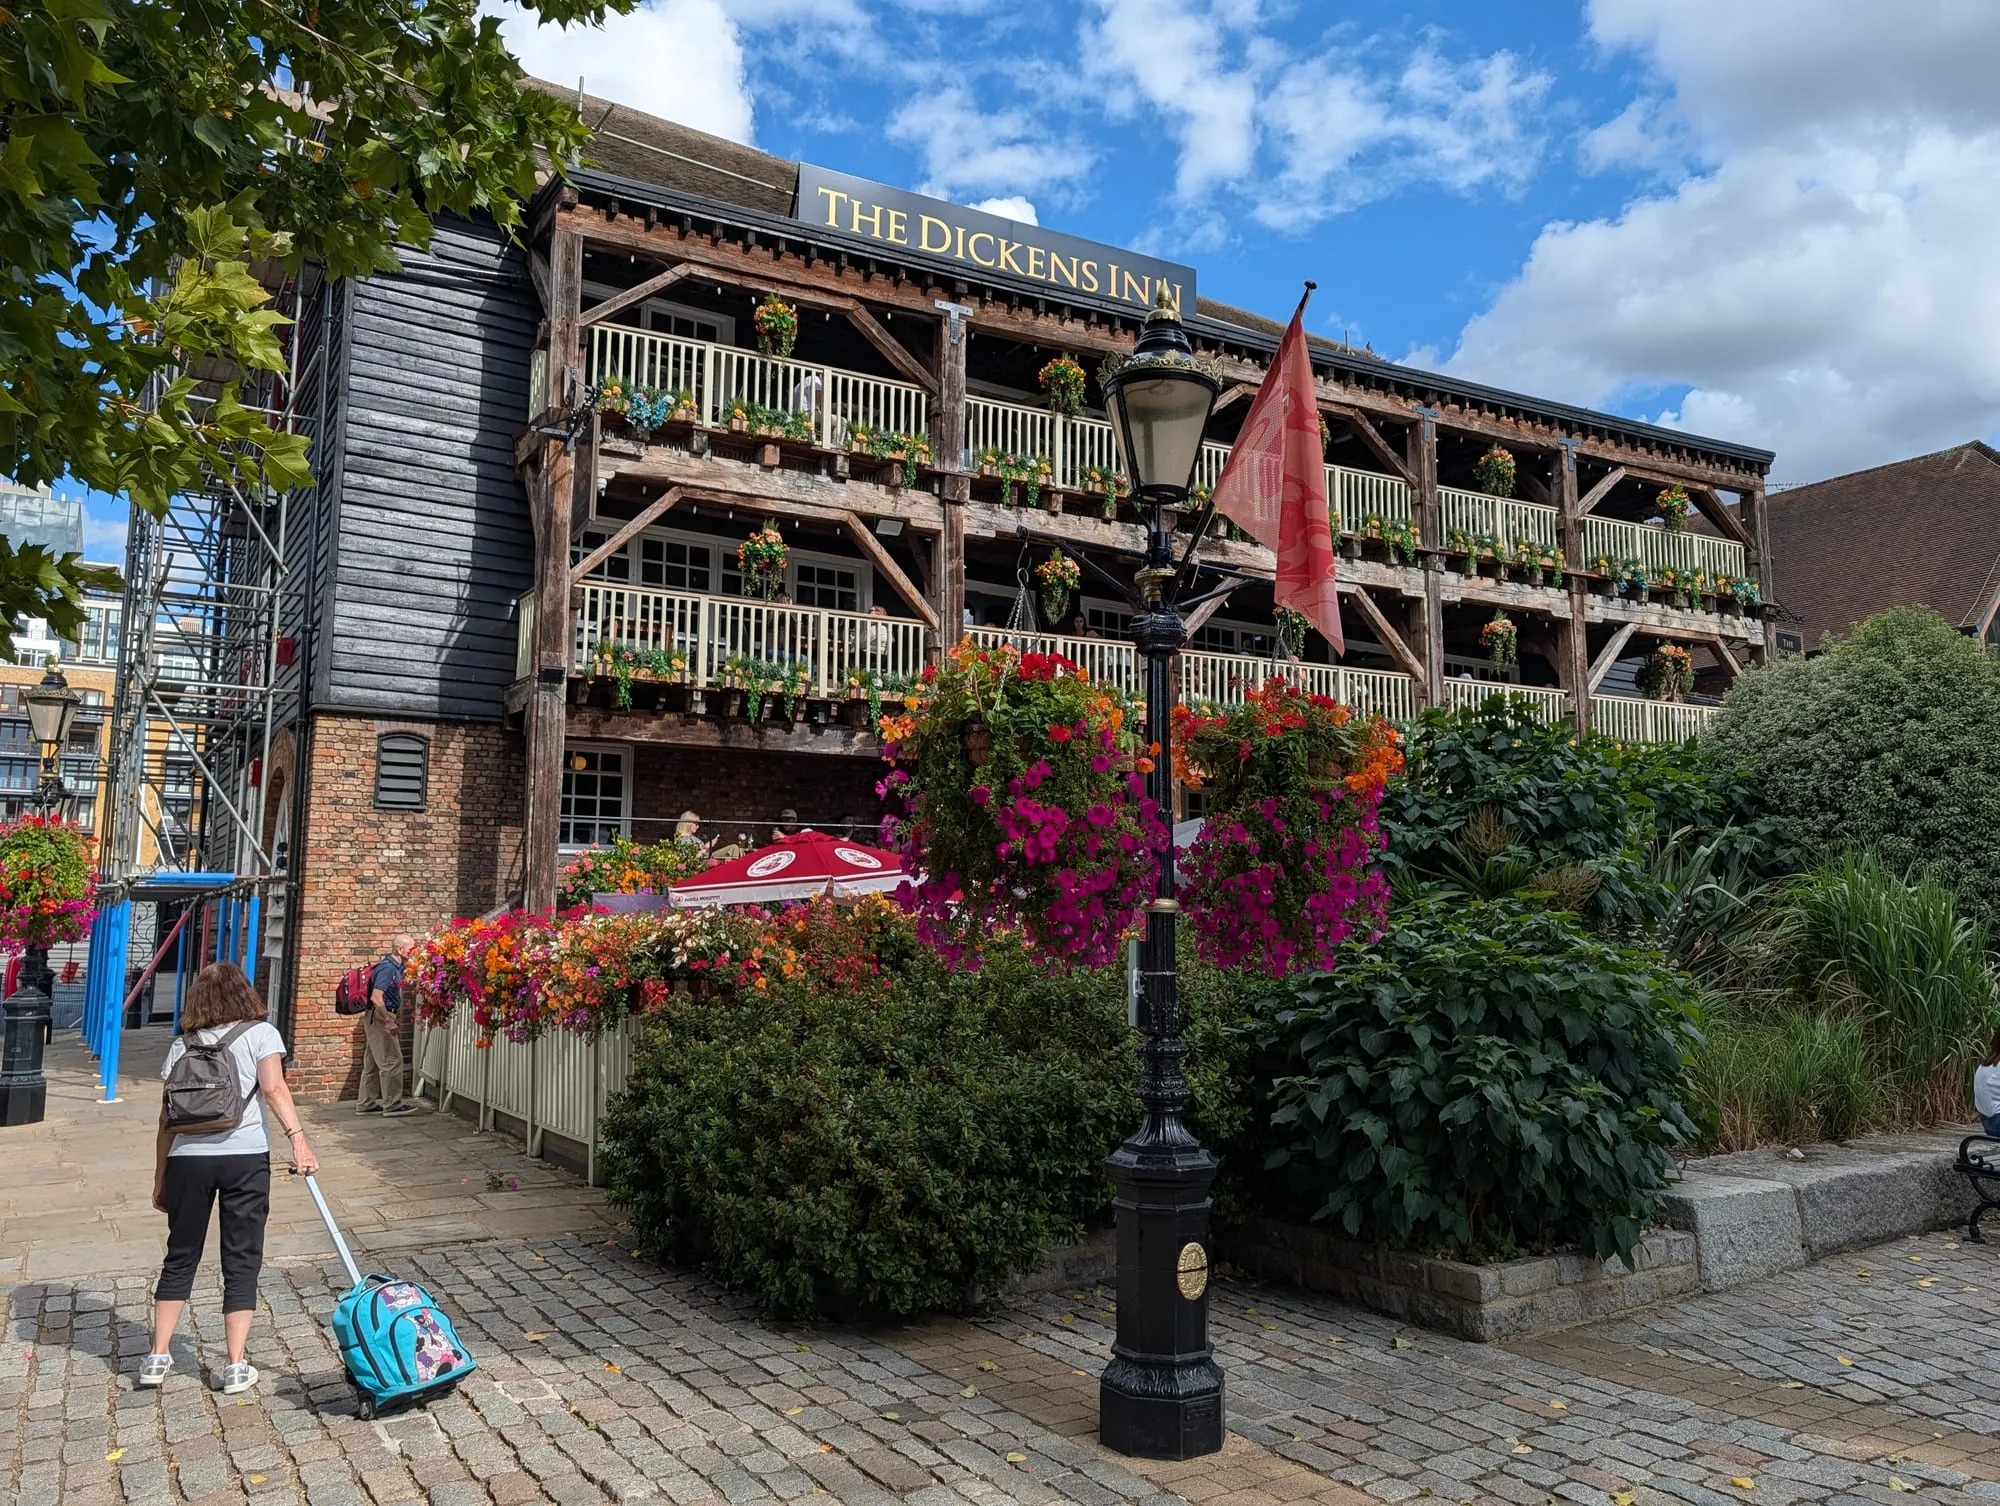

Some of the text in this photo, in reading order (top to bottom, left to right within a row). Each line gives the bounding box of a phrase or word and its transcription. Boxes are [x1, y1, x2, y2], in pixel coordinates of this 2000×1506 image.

[817, 186, 908, 245] THE
[918, 214, 1099, 293] DICKENS
[1782, 638, 1794, 649] THE
